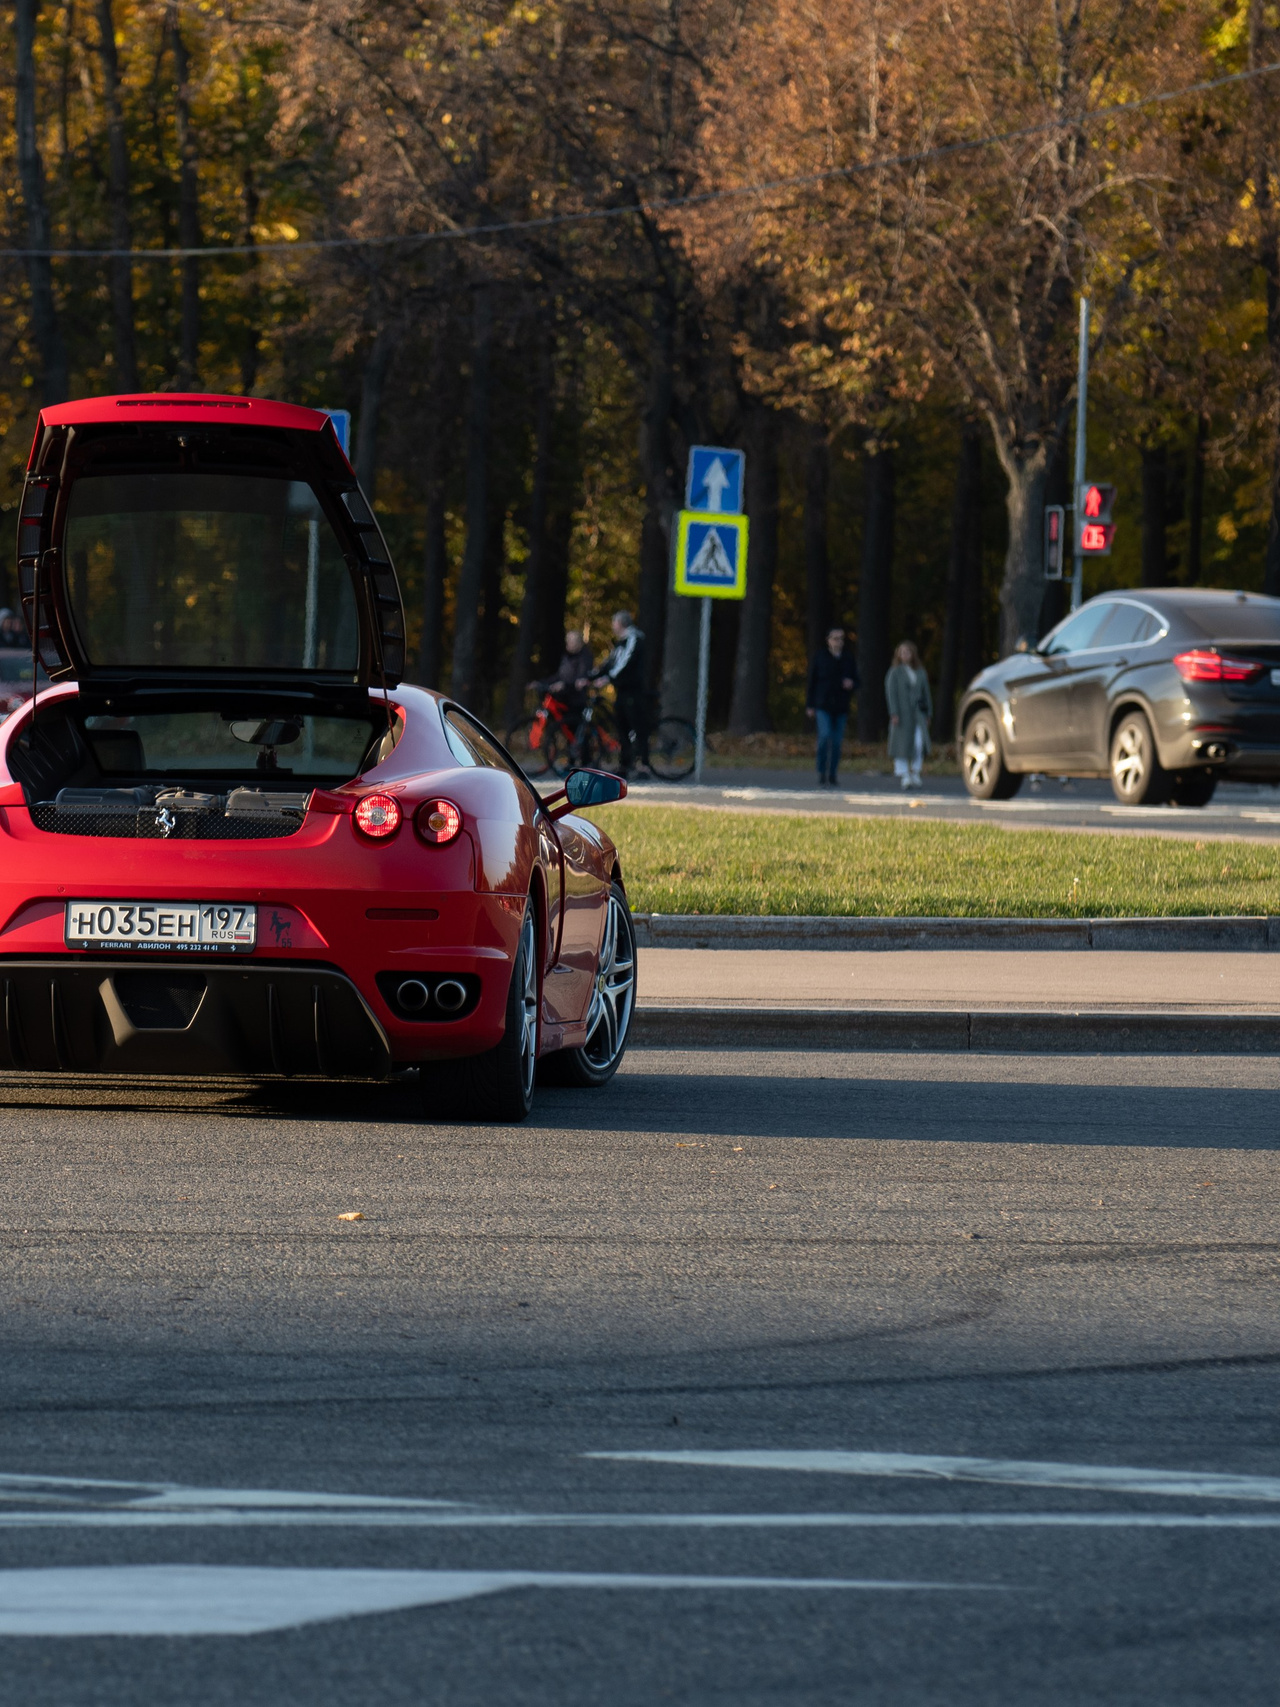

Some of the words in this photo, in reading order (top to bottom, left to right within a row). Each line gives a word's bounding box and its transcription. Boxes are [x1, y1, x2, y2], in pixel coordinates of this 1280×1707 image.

[77, 906, 195, 938] Н035ЕН
[201, 907, 246, 930] 197
[211, 930, 234, 939] RUS
[100, 941, 132, 949] FERRARI
[137, 942, 171, 950] АВИЛОН
[176, 943, 188, 951] 495
